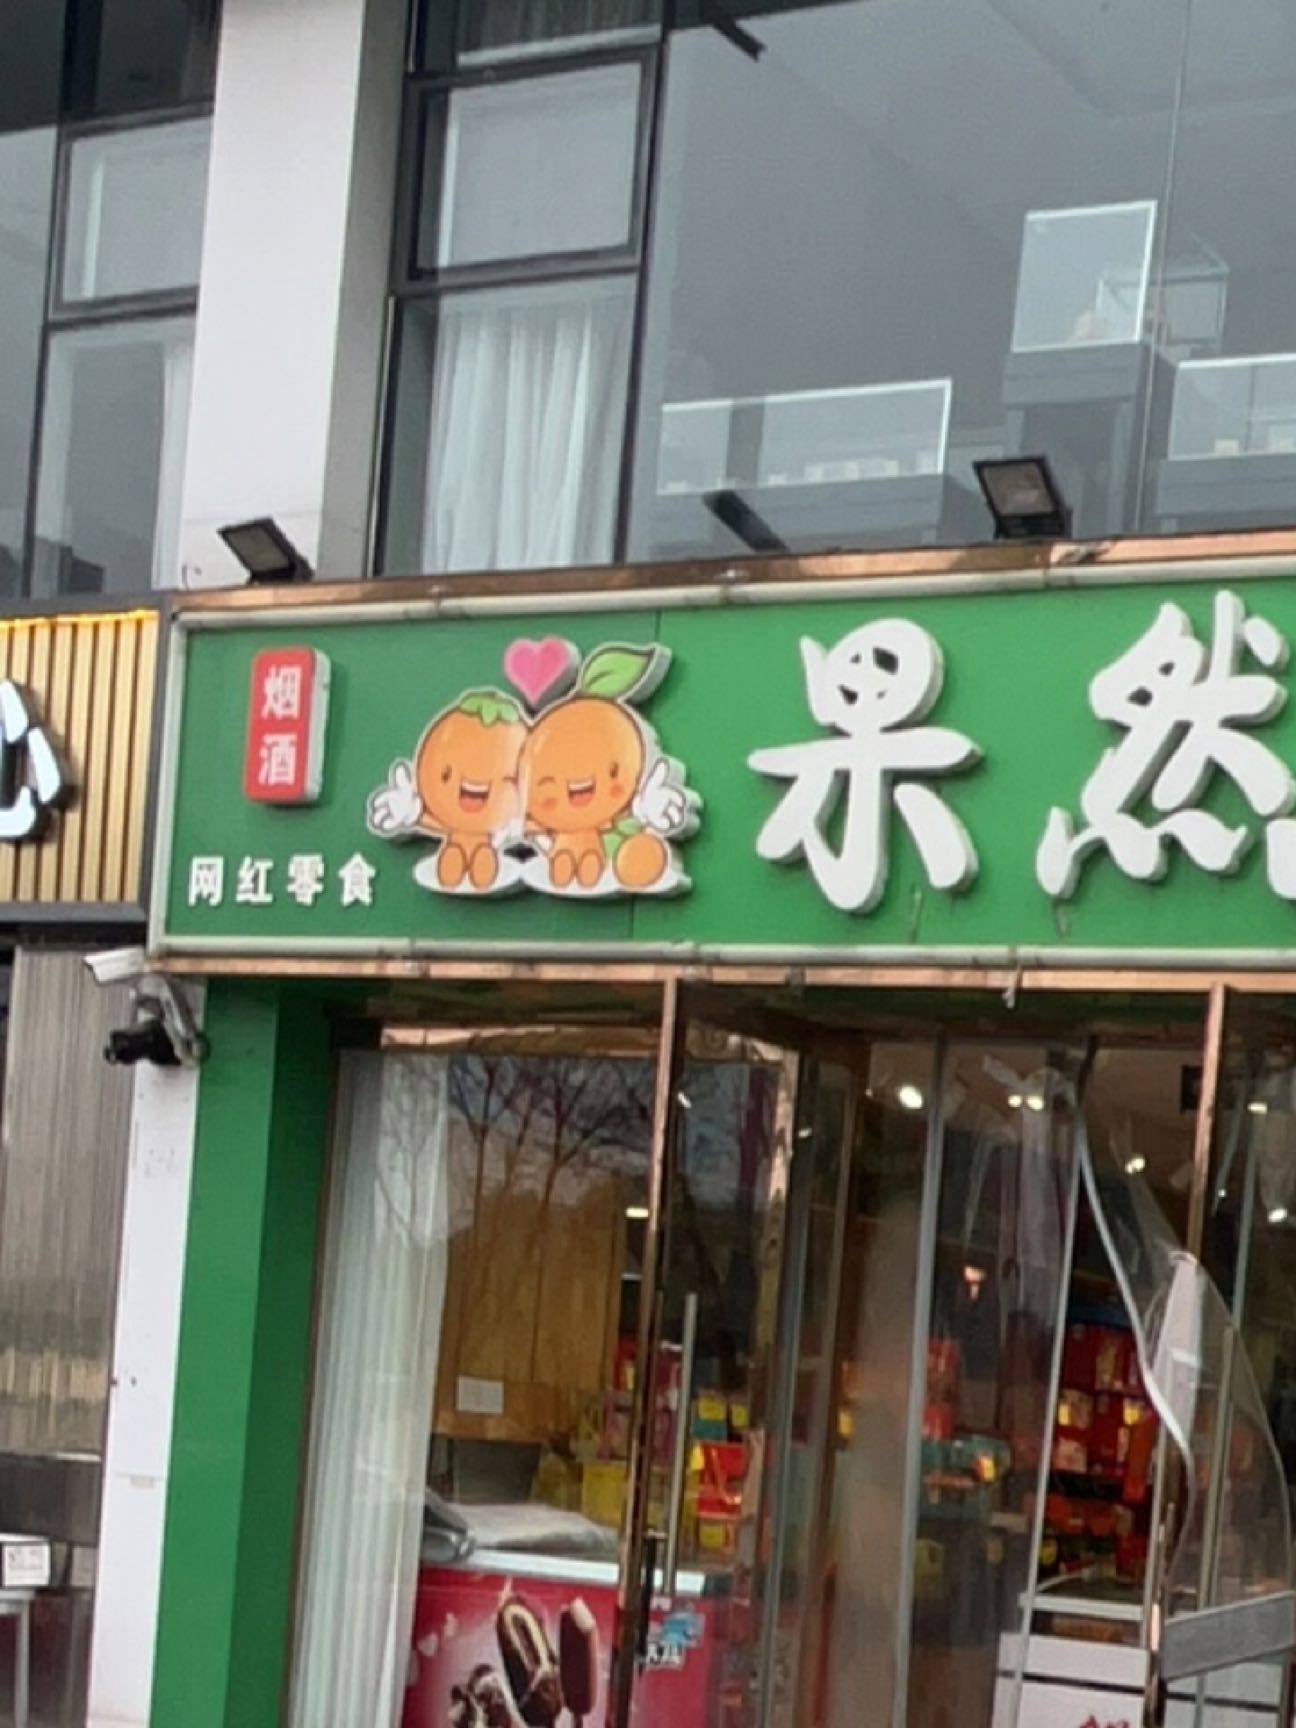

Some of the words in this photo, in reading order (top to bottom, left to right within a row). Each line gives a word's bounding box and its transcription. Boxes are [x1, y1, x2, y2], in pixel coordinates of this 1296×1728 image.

[259, 665, 303, 787] 烟酒
[187, 851, 377, 907] 网红零食
